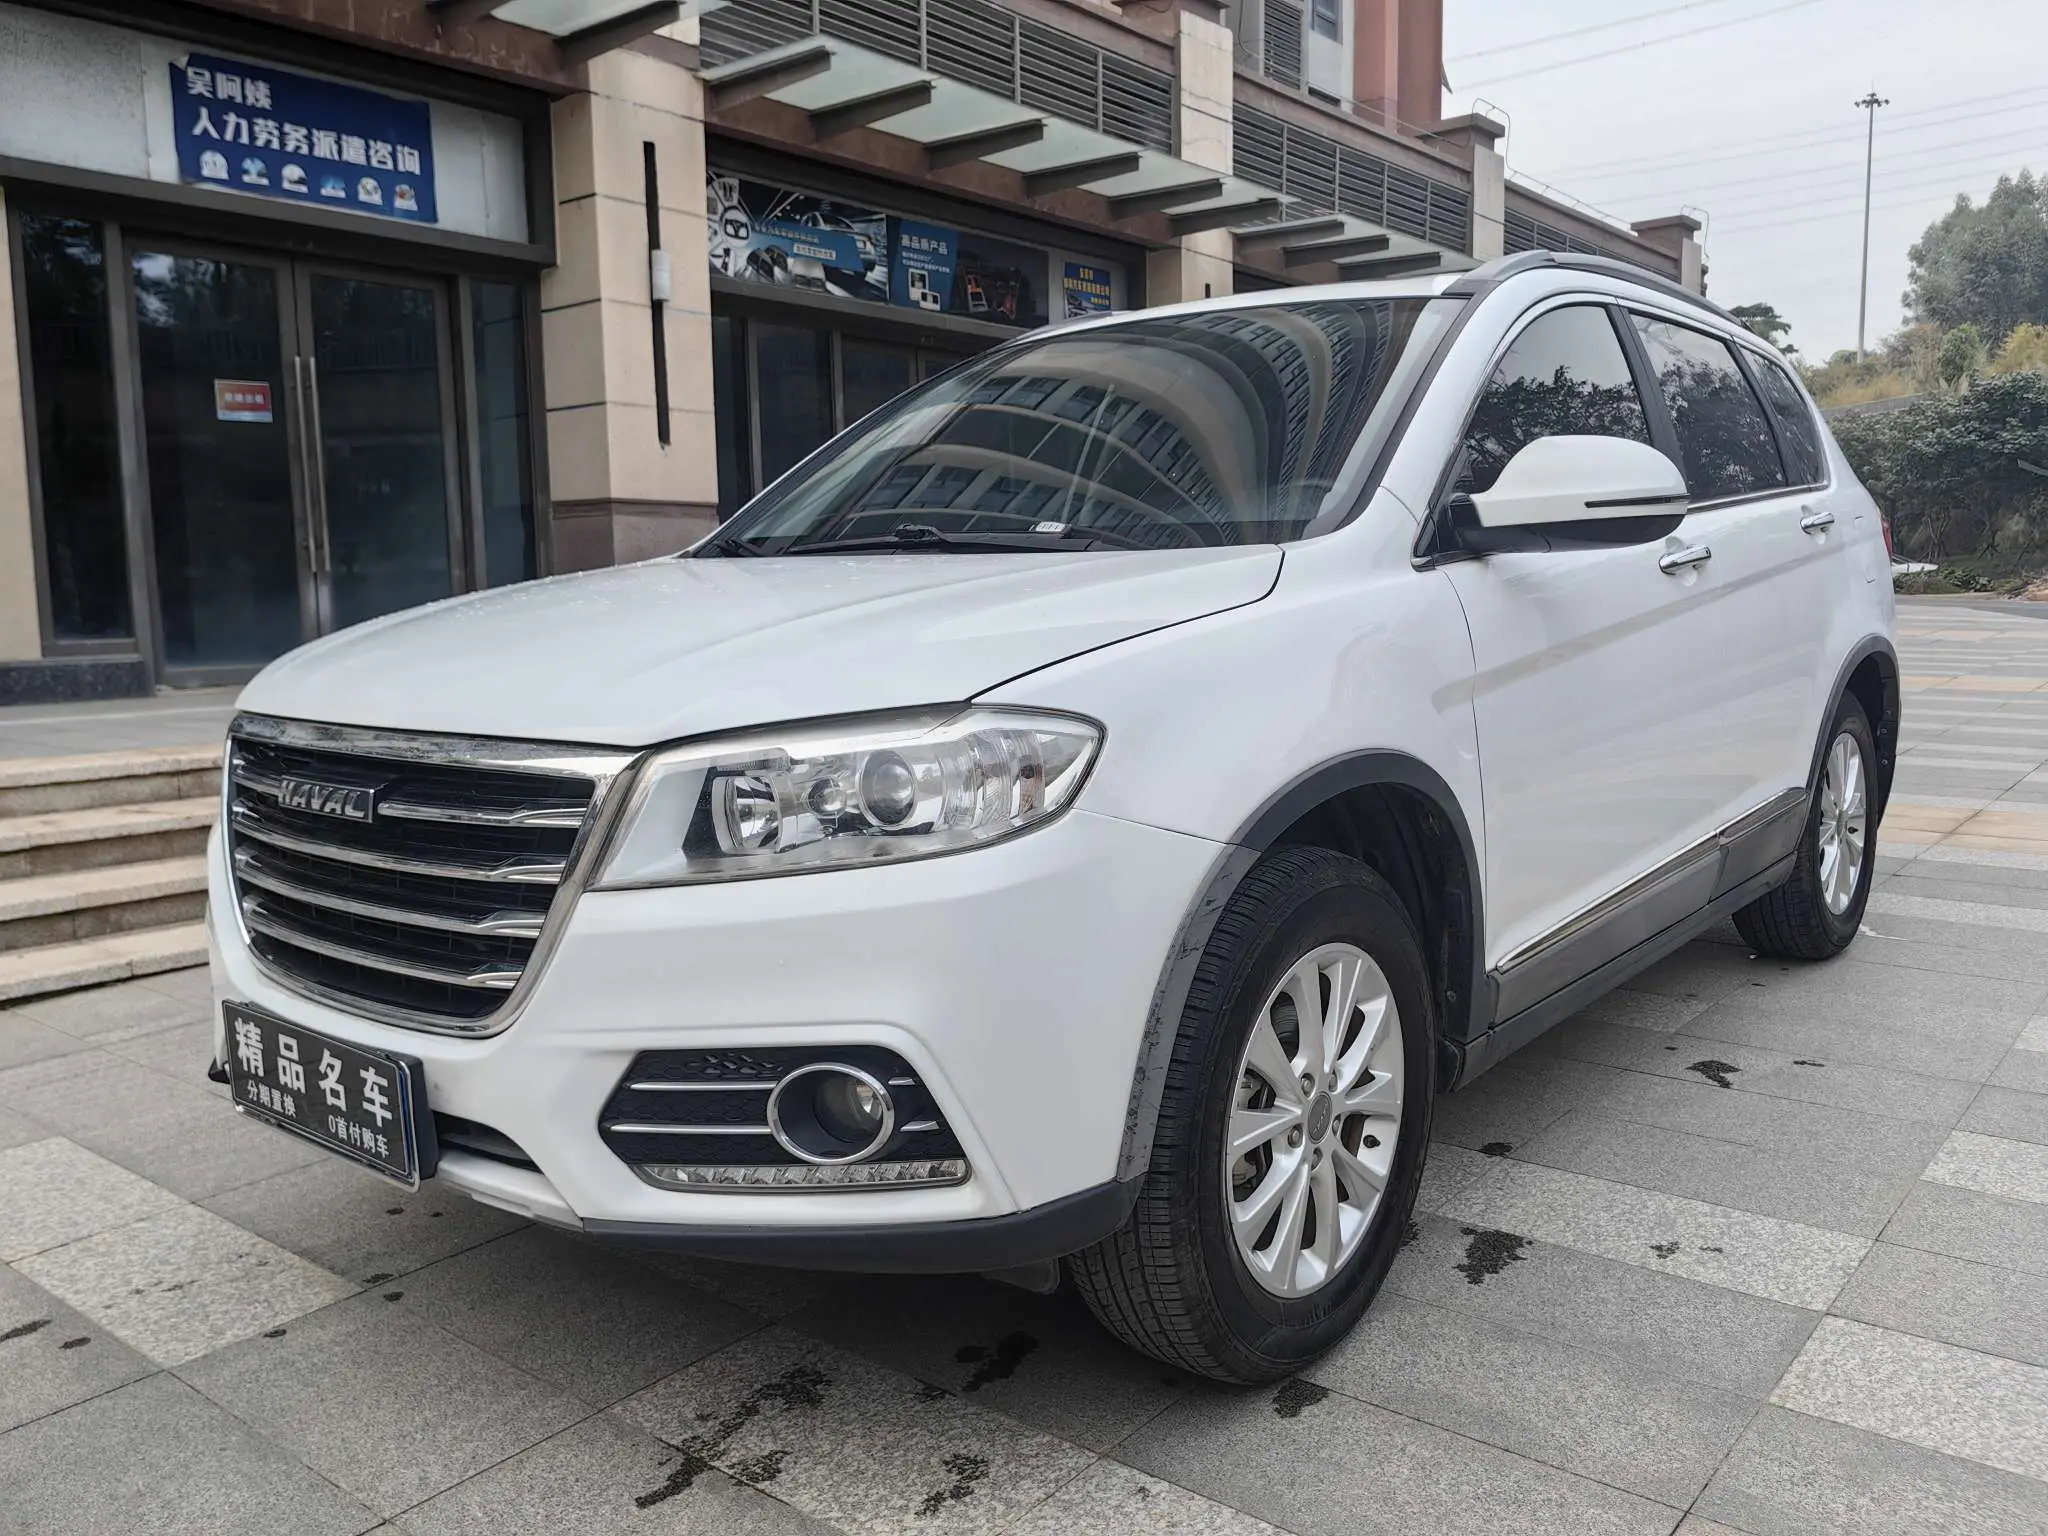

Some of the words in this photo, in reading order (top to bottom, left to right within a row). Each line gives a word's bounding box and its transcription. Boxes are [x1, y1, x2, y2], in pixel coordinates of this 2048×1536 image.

[192, 106, 421, 176] 人力劳务派遣咨询
[278, 780, 366, 818] HAVAL
[234, 1017, 393, 1128] 精品名车
[247, 1079, 297, 1118] 分期置换
[328, 1114, 390, 1159] 0首付购车
